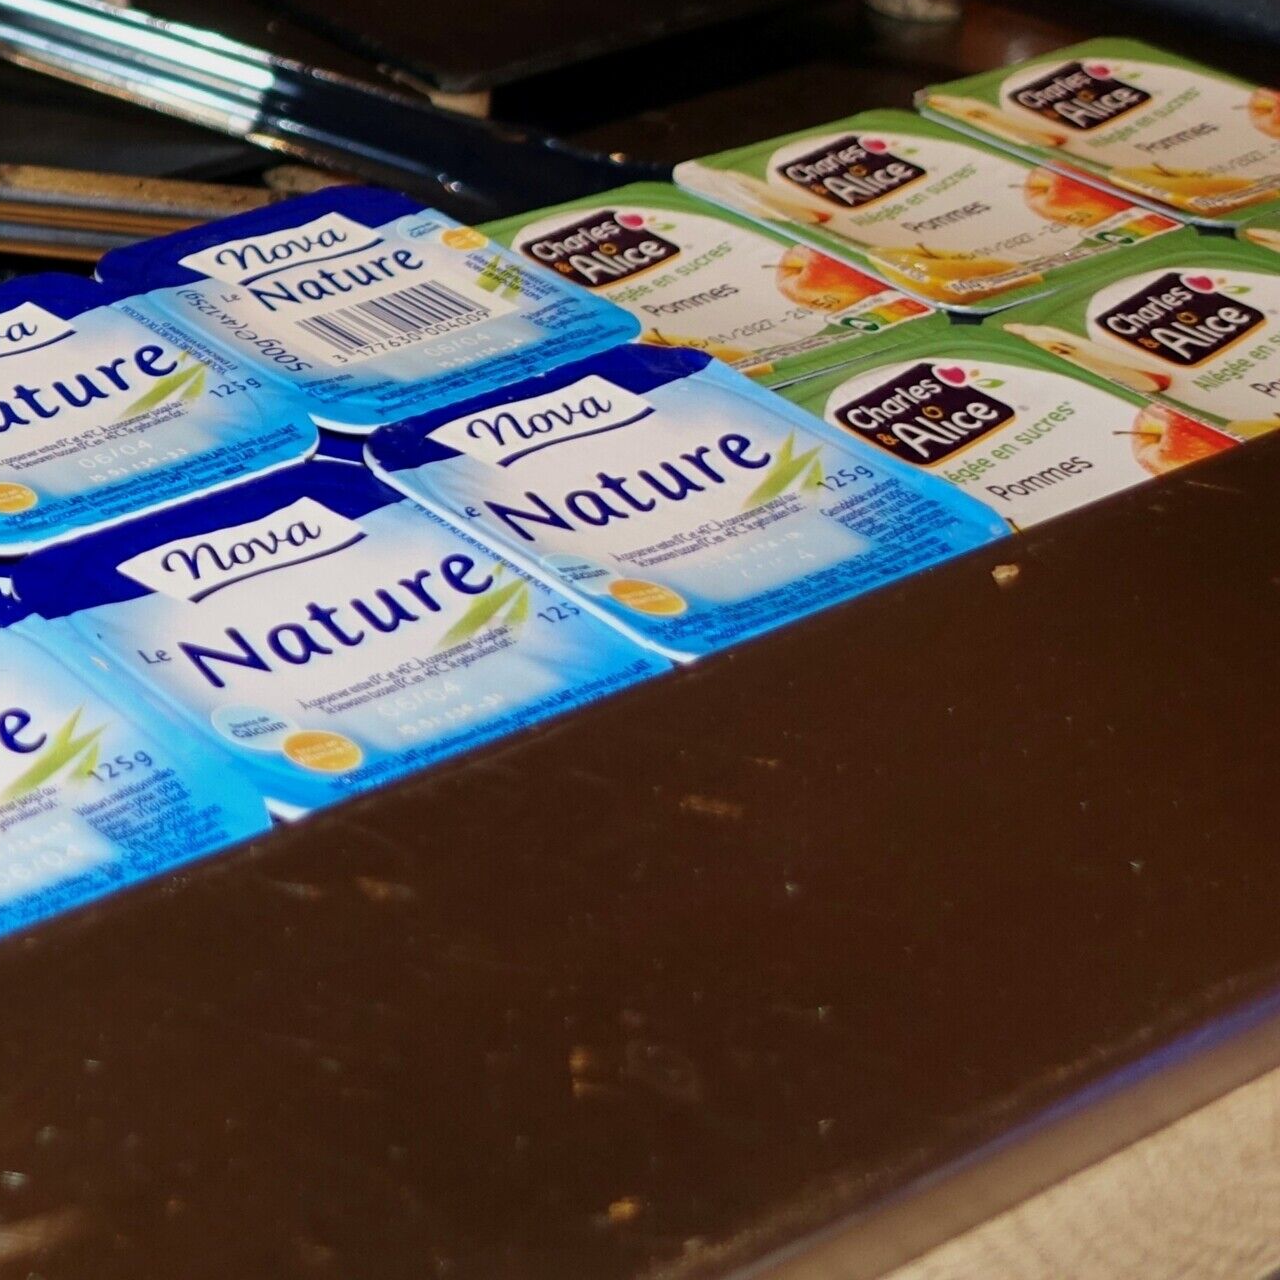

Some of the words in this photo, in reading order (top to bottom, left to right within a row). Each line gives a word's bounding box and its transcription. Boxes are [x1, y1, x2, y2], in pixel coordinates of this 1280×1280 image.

[786, 143, 867, 184] Charles
[824, 160, 916, 206] Alice
[901, 200, 992, 234] Pommes
[905, 193, 925, 207] en
[215, 225, 347, 271] Nova
[531, 219, 619, 262] Charles
[572, 236, 666, 285] Alice
[250, 247, 424, 312] Nature
[641, 282, 739, 318] Pommes
[652, 273, 675, 289] en
[1106, 286, 1194, 336] Charles
[1150, 306, 1251, 361] Alice
[333, 353, 349, 364] 3
[1191, 353, 1248, 392] Allégée
[1249, 342, 1270, 361] en
[209, 376, 262, 399] 125g
[845, 377, 943, 431] Charles
[466, 393, 611, 449] Nova
[892, 399, 999, 459] Alice
[993, 443, 1018, 464] en
[483, 432, 772, 542] Nature
[816, 465, 874, 492] 125g
[985, 454, 1093, 503] Pommes
[161, 521, 321, 581] Nova
[140, 645, 170, 666] Le
[177, 554, 494, 690] Nature
[86, 749, 154, 784] 125g
